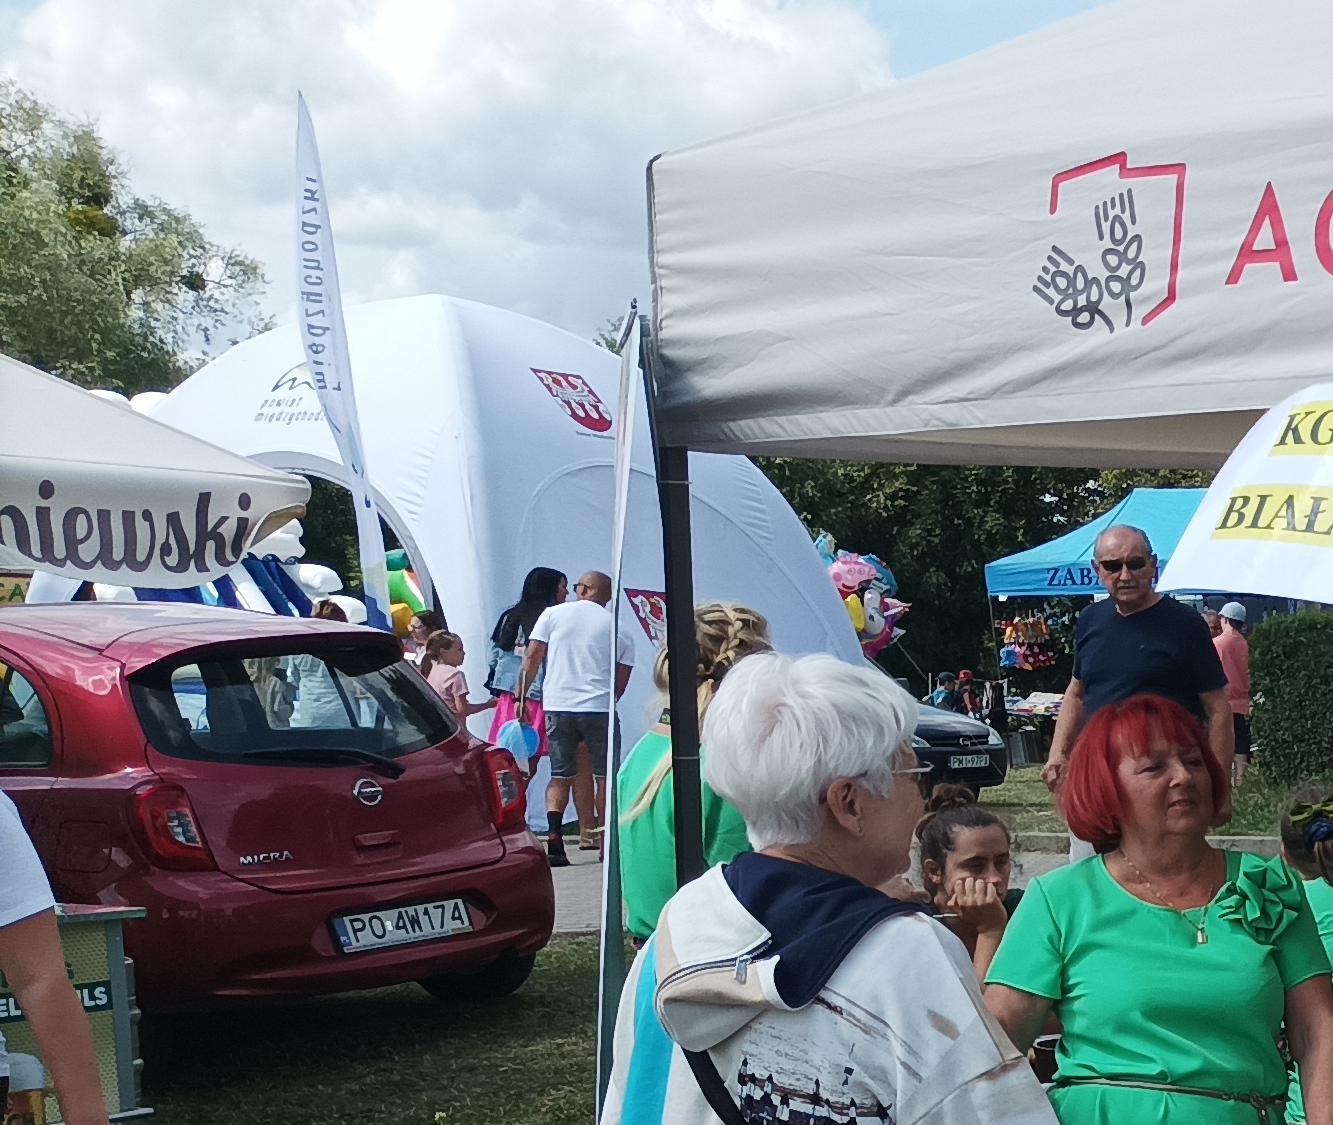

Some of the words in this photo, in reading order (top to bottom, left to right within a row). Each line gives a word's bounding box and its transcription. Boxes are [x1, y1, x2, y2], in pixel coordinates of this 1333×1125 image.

[239, 850, 293, 865] MICRA
[350, 914, 386, 943] PO
[394, 901, 465, 935] 4W174
